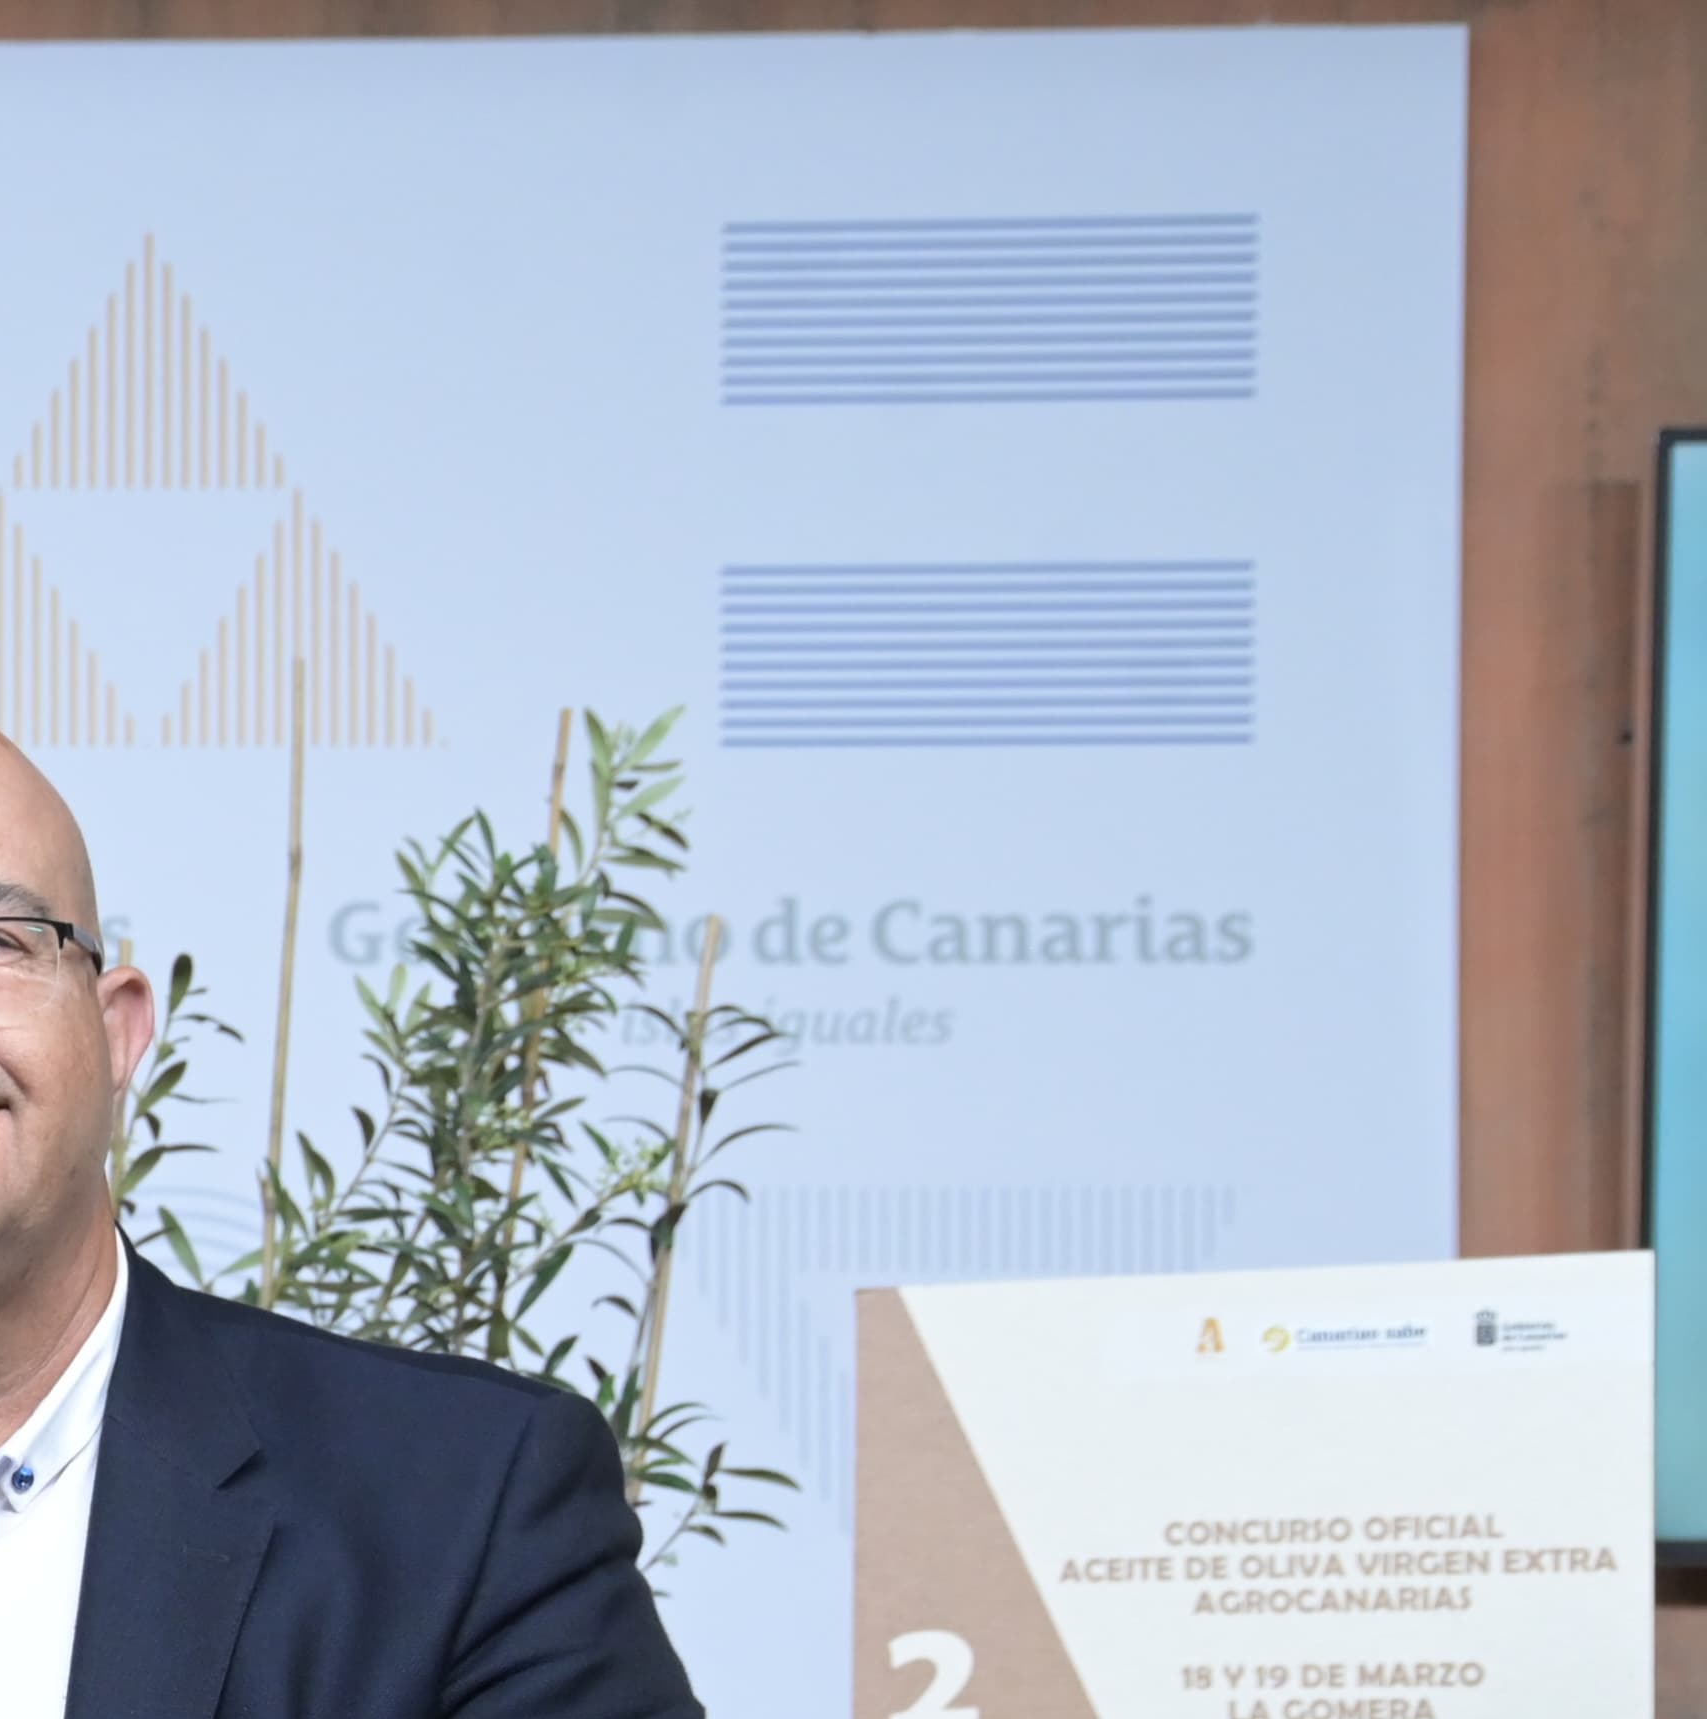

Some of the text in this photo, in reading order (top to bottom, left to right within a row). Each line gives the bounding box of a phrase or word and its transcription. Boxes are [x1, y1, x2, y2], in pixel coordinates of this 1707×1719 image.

[752, 895, 851, 966] de
[869, 894, 1254, 966] Canarias
[1164, 1513, 1503, 1547] CONCURSO OFICIAL
[1060, 1546, 1617, 1585] ACEITE DE OLIVA VIRGEN EXTRA
[1194, 1583, 1472, 1615] AGROCANARIAS
[1181, 1660, 1484, 1690] 18 Y 19 DE MARZO
